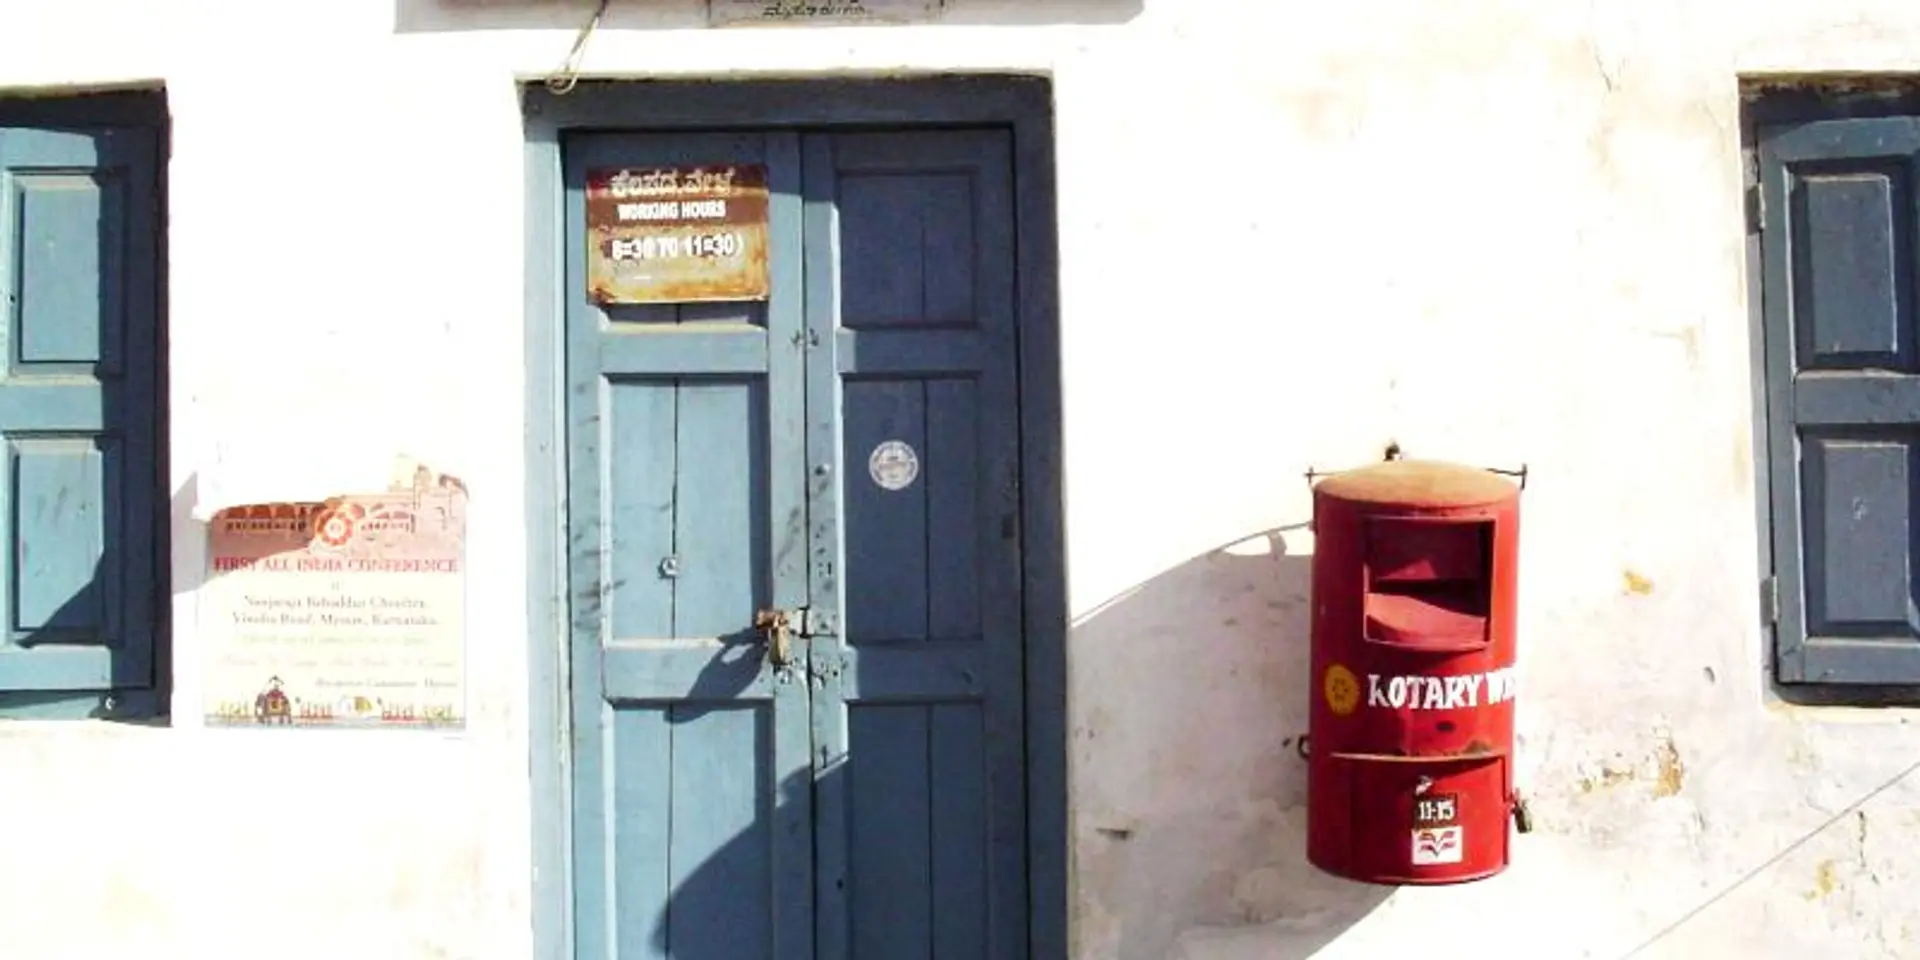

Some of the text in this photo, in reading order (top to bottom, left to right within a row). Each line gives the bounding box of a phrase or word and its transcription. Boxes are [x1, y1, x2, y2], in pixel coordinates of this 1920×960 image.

[617, 200, 727, 221] WORKING HOURS
[213, 556, 460, 573] FIRST ALL INDIA CONFERENCE
